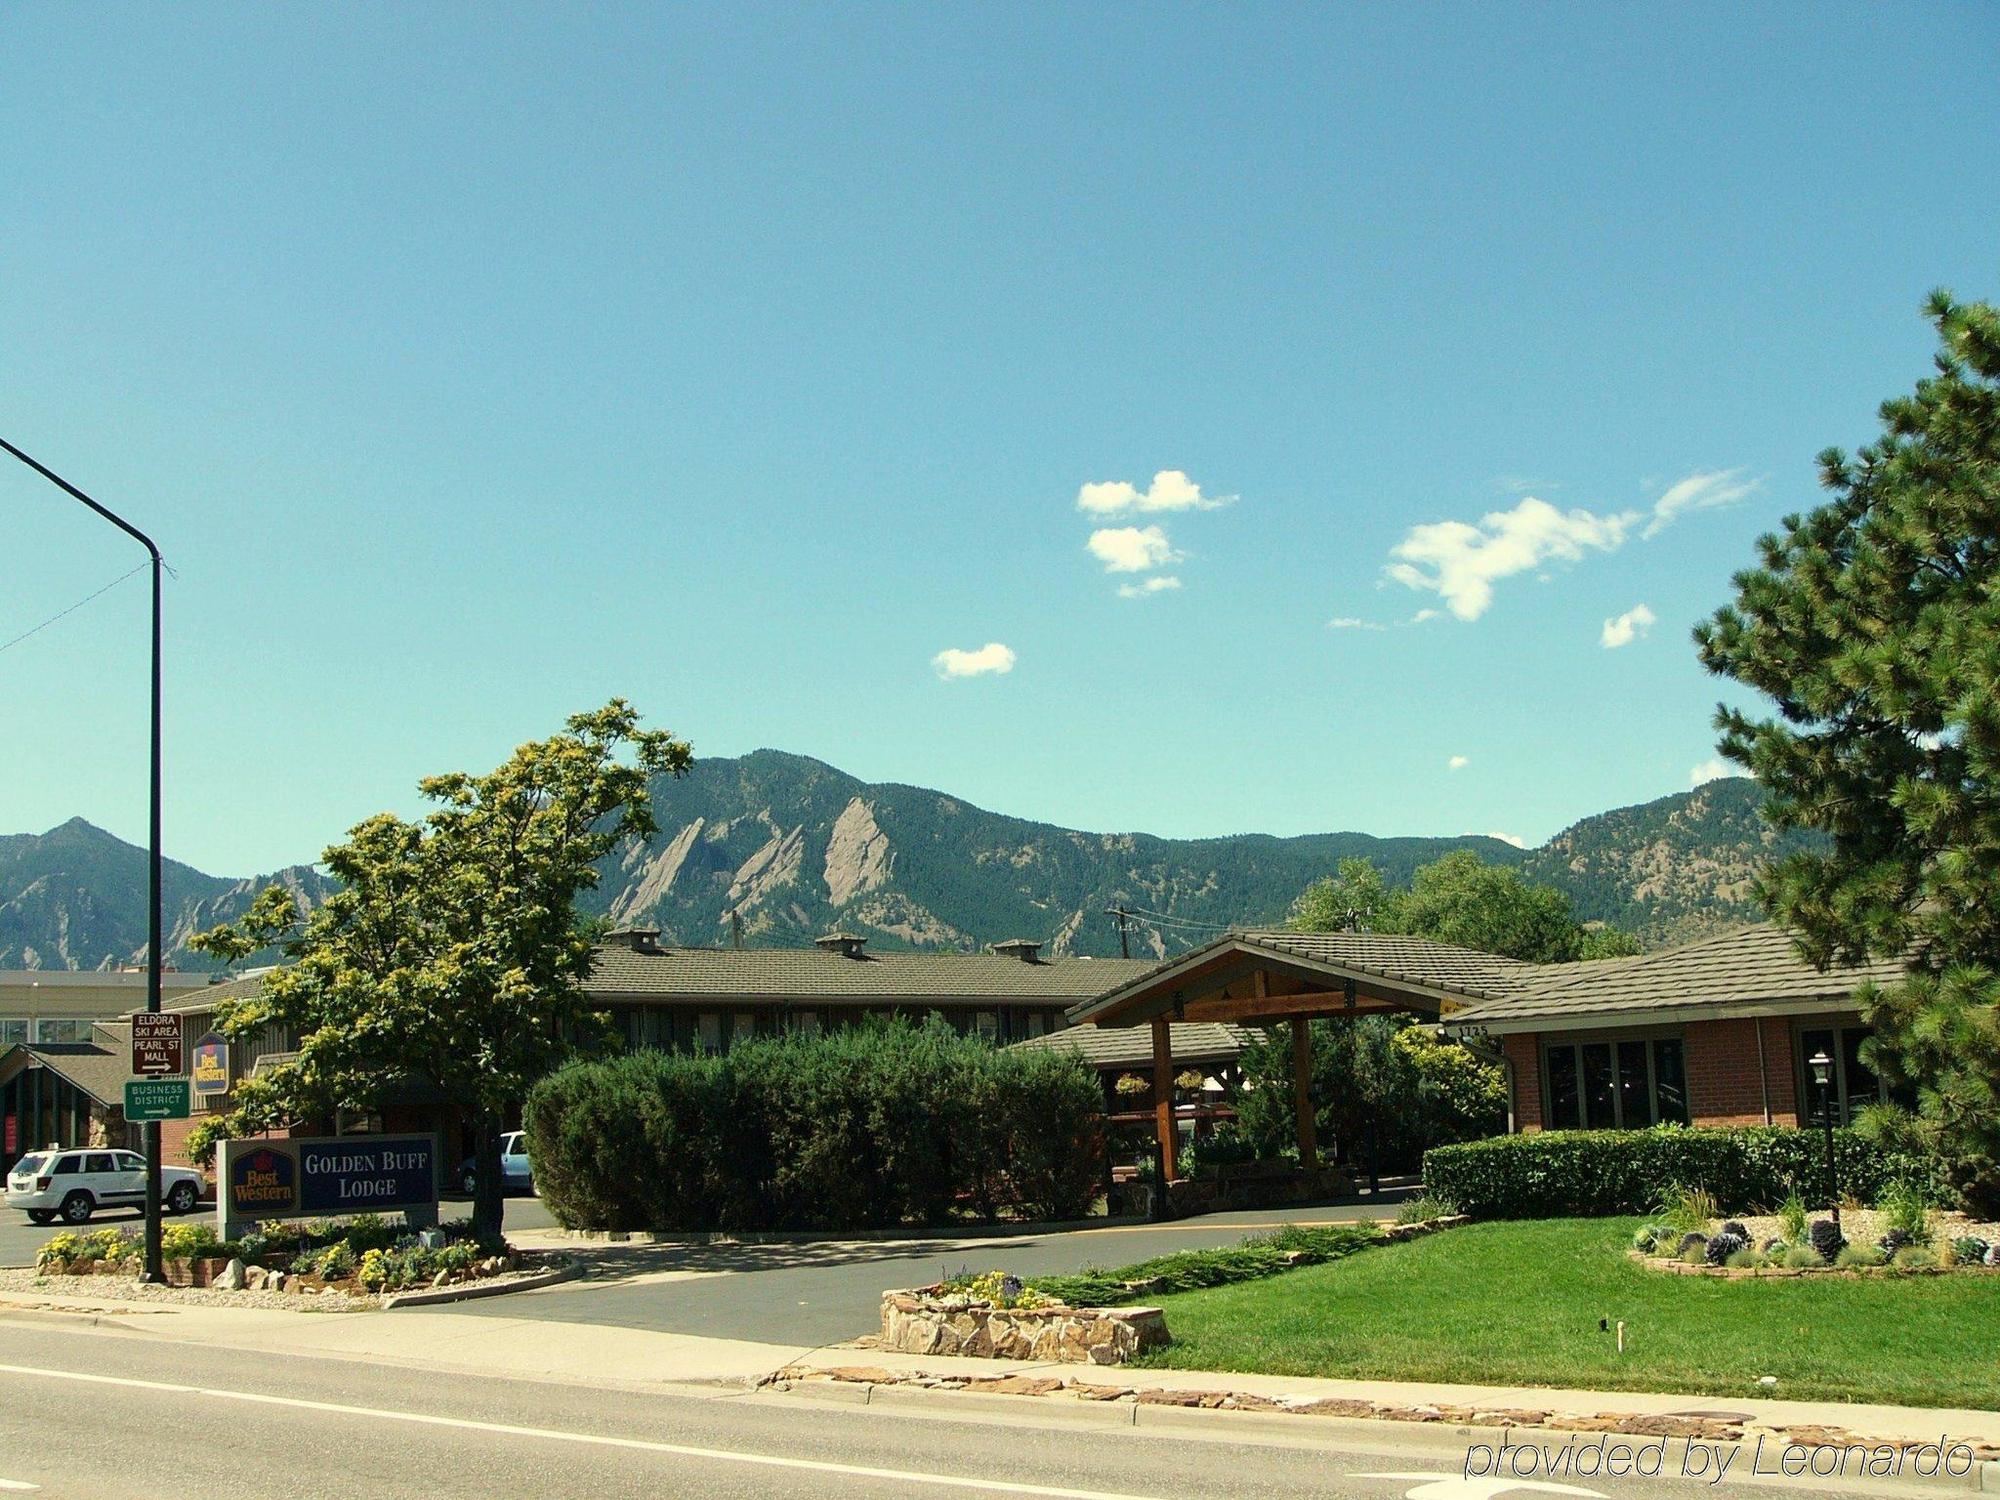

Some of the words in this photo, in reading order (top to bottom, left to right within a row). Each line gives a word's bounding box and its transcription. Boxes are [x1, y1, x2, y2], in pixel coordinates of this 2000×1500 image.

[138, 1016, 175, 1025] ELDORA
[135, 1027, 150, 1036] SKI
[153, 1028, 179, 1036] AREA
[1459, 1025, 1488, 1036] 1725
[134, 1041, 164, 1050] PEARL
[168, 1041, 180, 1049] ST
[144, 1052, 169, 1061] MALL
[201, 1054, 218, 1068] Best
[132, 1085, 184, 1095] BUSINESS
[134, 1096, 181, 1105] DISTRICT
[306, 1154, 376, 1175] GOLDEN
[382, 1151, 428, 1171] BUFF
[246, 1171, 278, 1187] Best
[235, 1186, 291, 1200] Western
[339, 1179, 397, 1199] LODGE
